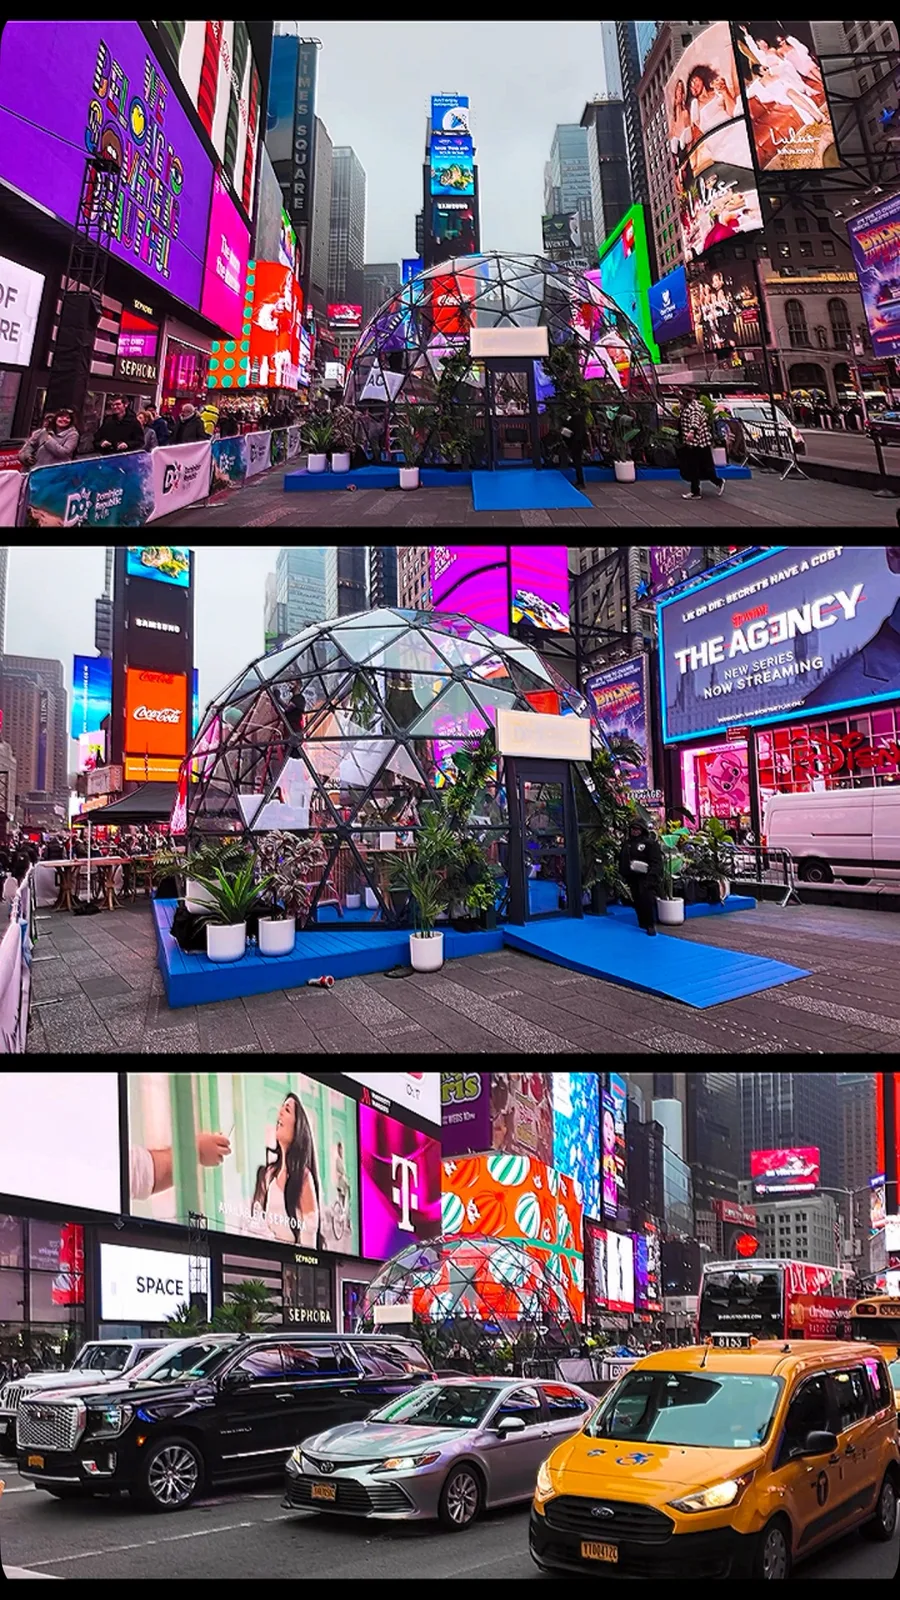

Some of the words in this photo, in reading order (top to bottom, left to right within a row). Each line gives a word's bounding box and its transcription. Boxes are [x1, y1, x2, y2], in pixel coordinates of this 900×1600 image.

[298, 51, 310, 115] TIMES
[294, 124, 308, 210] SQUARE
[769, 565, 800, 586] HAVE
[800, 560, 810, 572] A
[674, 635, 725, 675] THE
[724, 664, 749, 680] NEW
[753, 651, 794, 671] SERIES
[703, 682, 732, 699] NOW
[737, 657, 824, 690] STREAMING
[136, 1276, 184, 1297] SPACE
[289, 1308, 332, 1323] SEPHORA
